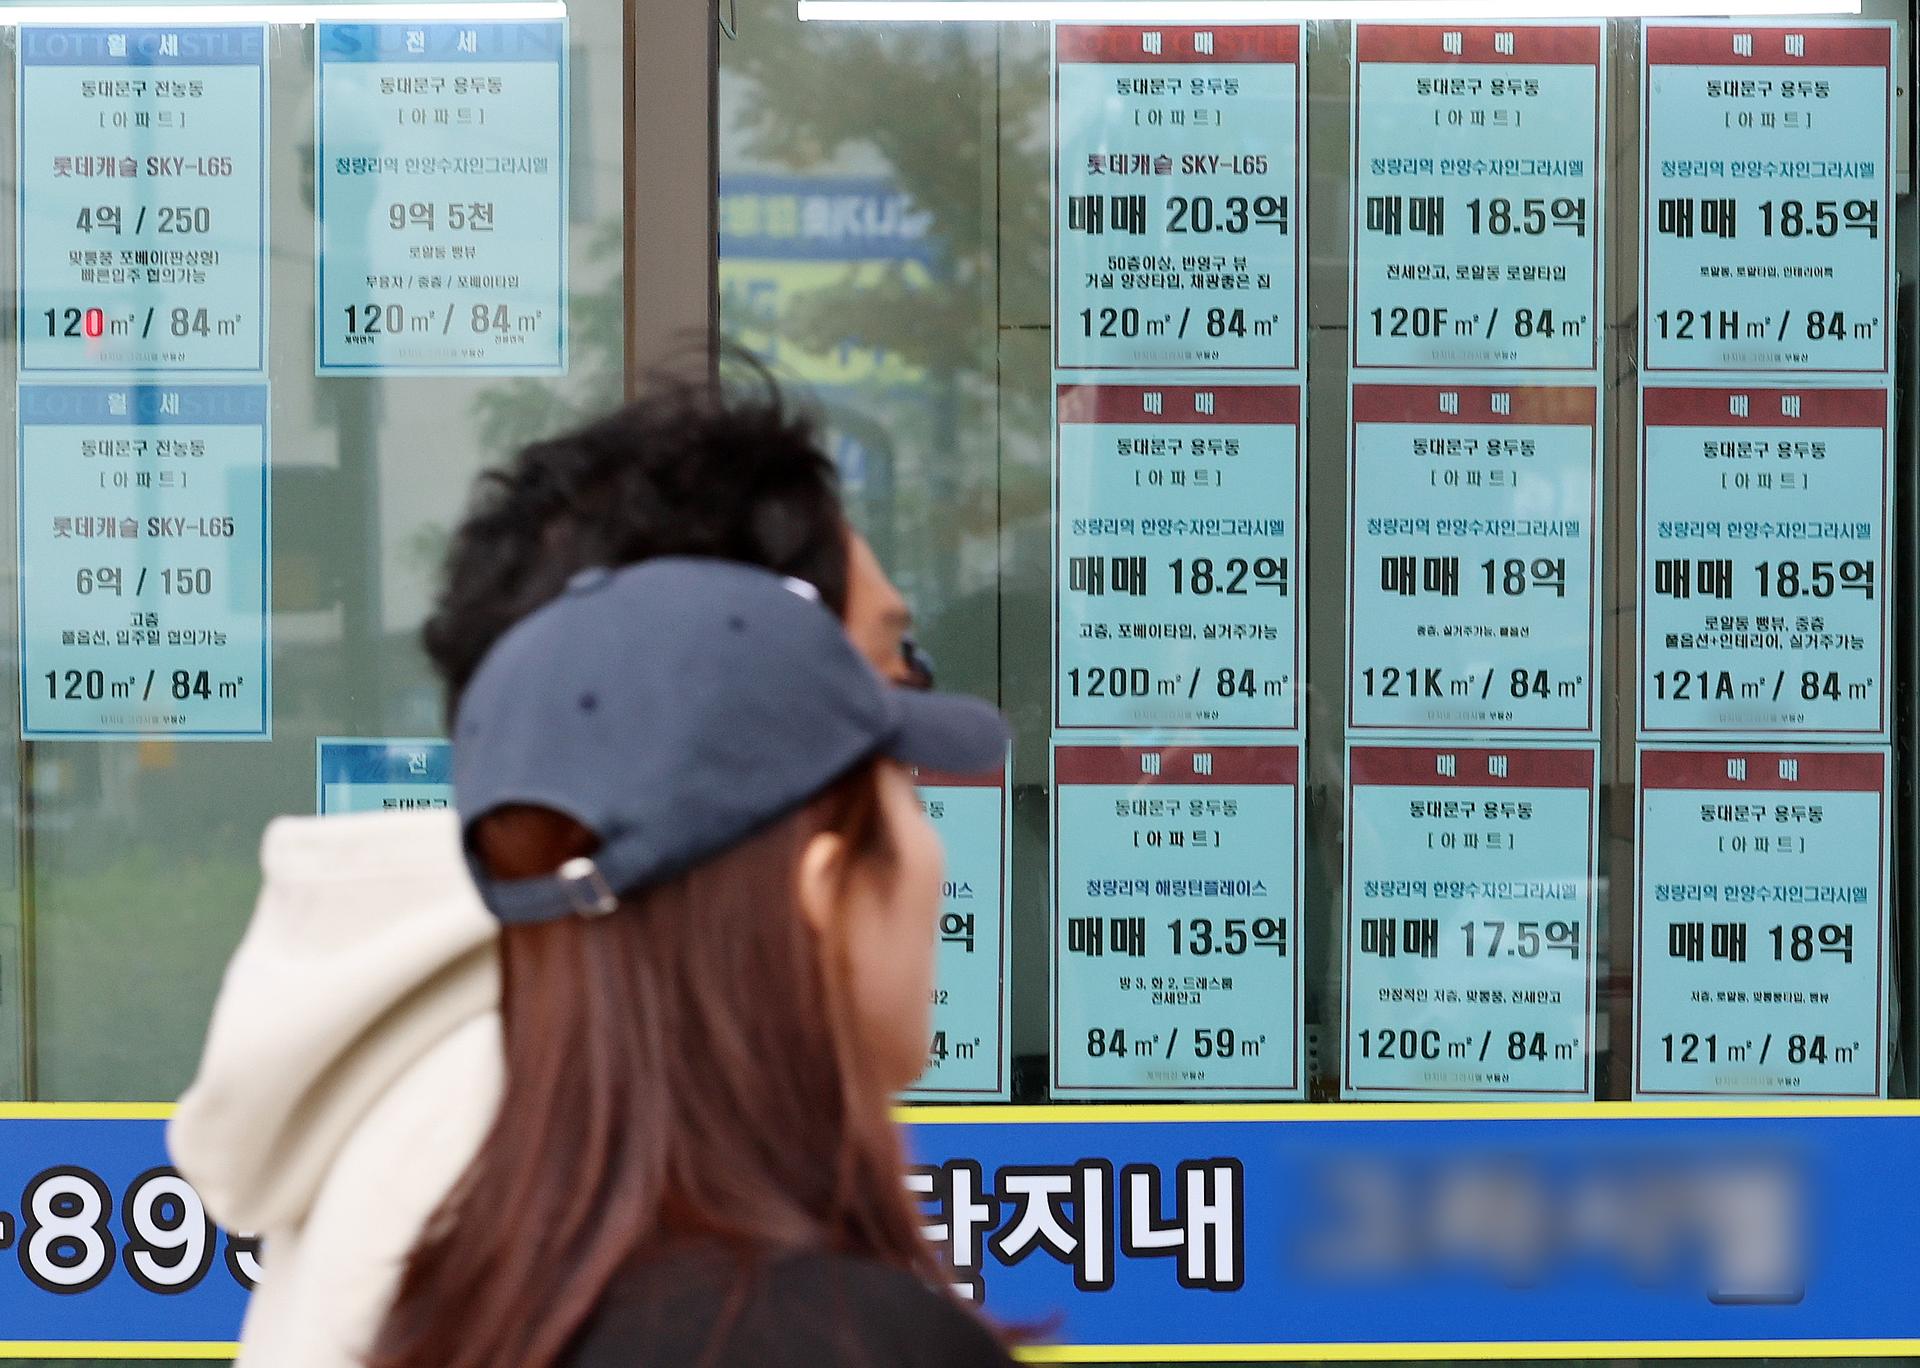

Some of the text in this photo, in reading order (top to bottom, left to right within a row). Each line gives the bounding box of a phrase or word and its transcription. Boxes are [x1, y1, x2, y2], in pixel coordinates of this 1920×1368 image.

[82, 80, 203, 97] 동대문구 전농동
[380, 77, 501, 94] 동대문구 용두동
[1117, 78, 1239, 95] 동대문구 용두동
[1418, 78, 1538, 96] 동대문구 용두동
[1707, 80, 1829, 98] 동대문구 용두동
[53, 156, 232, 178] 롯데캐슬 SKY-L65
[336, 157, 547, 175] 청량리역 한양수자인그라시엘
[1087, 154, 1267, 176] 롯데캐슬 SKY-L65
[1371, 158, 1583, 177] 청량리역 한양수자인그라시엘
[1661, 160, 1874, 179] 청량리역 한양수자인그라시엘
[77, 206, 121, 236] 4억
[158, 207, 209, 234] 250
[390, 201, 493, 232] 9억 5천
[1069, 194, 1287, 236] 매매 20.3억
[1367, 195, 1585, 238] 매매 18.5억
[1659, 198, 1878, 239] 매매 18.5억
[82, 440, 204, 457] 동대문구 전농동
[1117, 438, 1239, 456] 동대문구 용두동
[1414, 438, 1535, 456] 동대문구 용두동
[1704, 441, 1825, 459] 동대문구 용두동
[53, 516, 234, 539] 롯데캐슬 SKY-L65
[1072, 518, 1284, 537] 청량리역 한양수자인그라시엘
[1367, 518, 1579, 538] 청량리역 한양수자인그라시엘
[1658, 520, 1870, 540] 청량리역 한양수자인그라시엘
[77, 567, 121, 596] 6억
[161, 568, 211, 595] 150
[1070, 556, 1287, 597] 매매 18.2억
[1381, 555, 1565, 598] 매매 18억
[1655, 559, 1874, 600] 매매 18.5억
[1116, 799, 1237, 817] 동대문구 용두동
[1410, 801, 1532, 819] 동대문구 용두동
[1701, 805, 1823, 823] 동대문구 용두동
[1087, 879, 1267, 897] 청량리역 해링턴플레이스
[1364, 881, 1576, 901] 청량리역 한양수자인그라시엘
[1655, 884, 1867, 904] 청량리역 한양수자인그라시엘
[1068, 916, 1286, 958] 매매 13.5억
[1361, 918, 1579, 960] 매매 17.5억
[1669, 922, 1852, 964] 매매 18억
